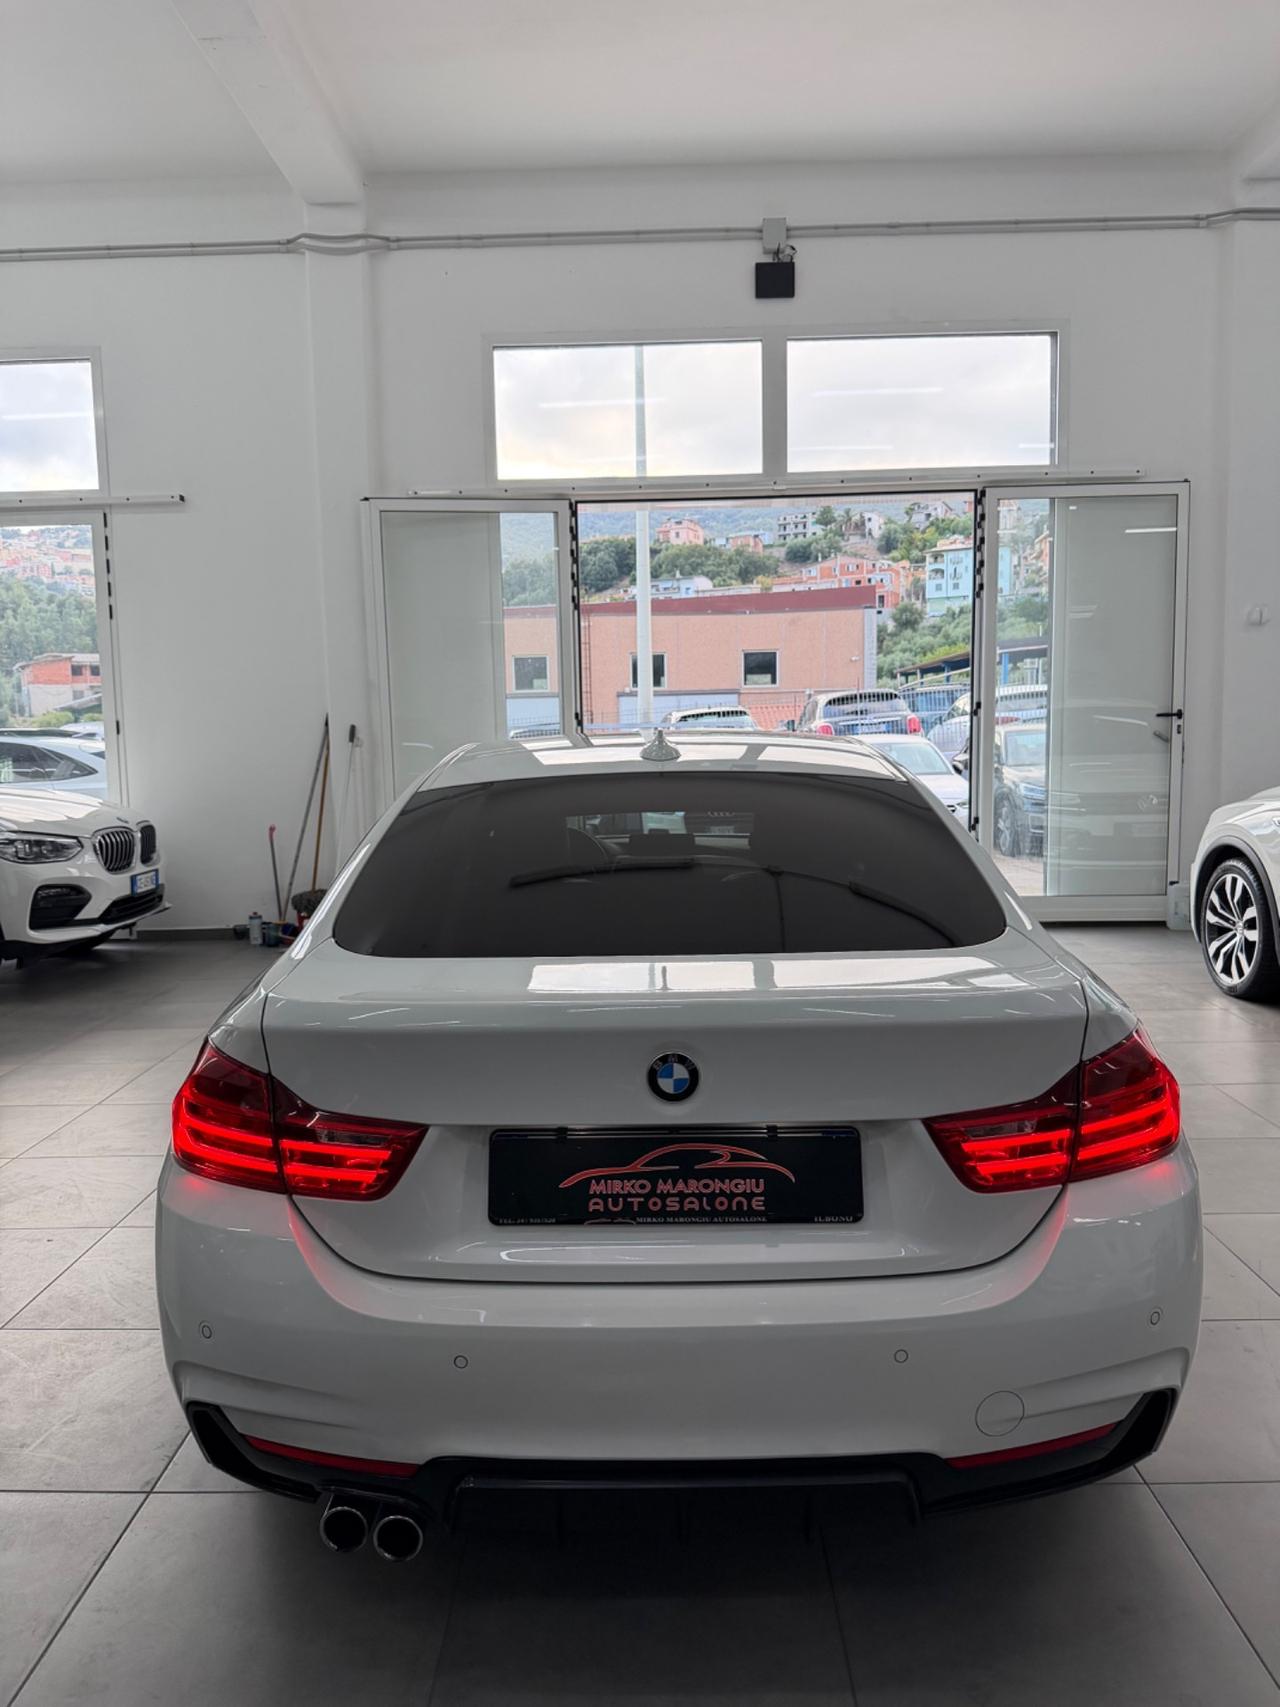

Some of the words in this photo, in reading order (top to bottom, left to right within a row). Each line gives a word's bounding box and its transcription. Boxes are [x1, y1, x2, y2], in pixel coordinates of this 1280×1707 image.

[652, 1053, 696, 1071] BMW
[589, 1179, 651, 1194] MIRKO
[656, 1178, 766, 1194] MARONGIU
[588, 1196, 766, 1212] AUTOSALONE
